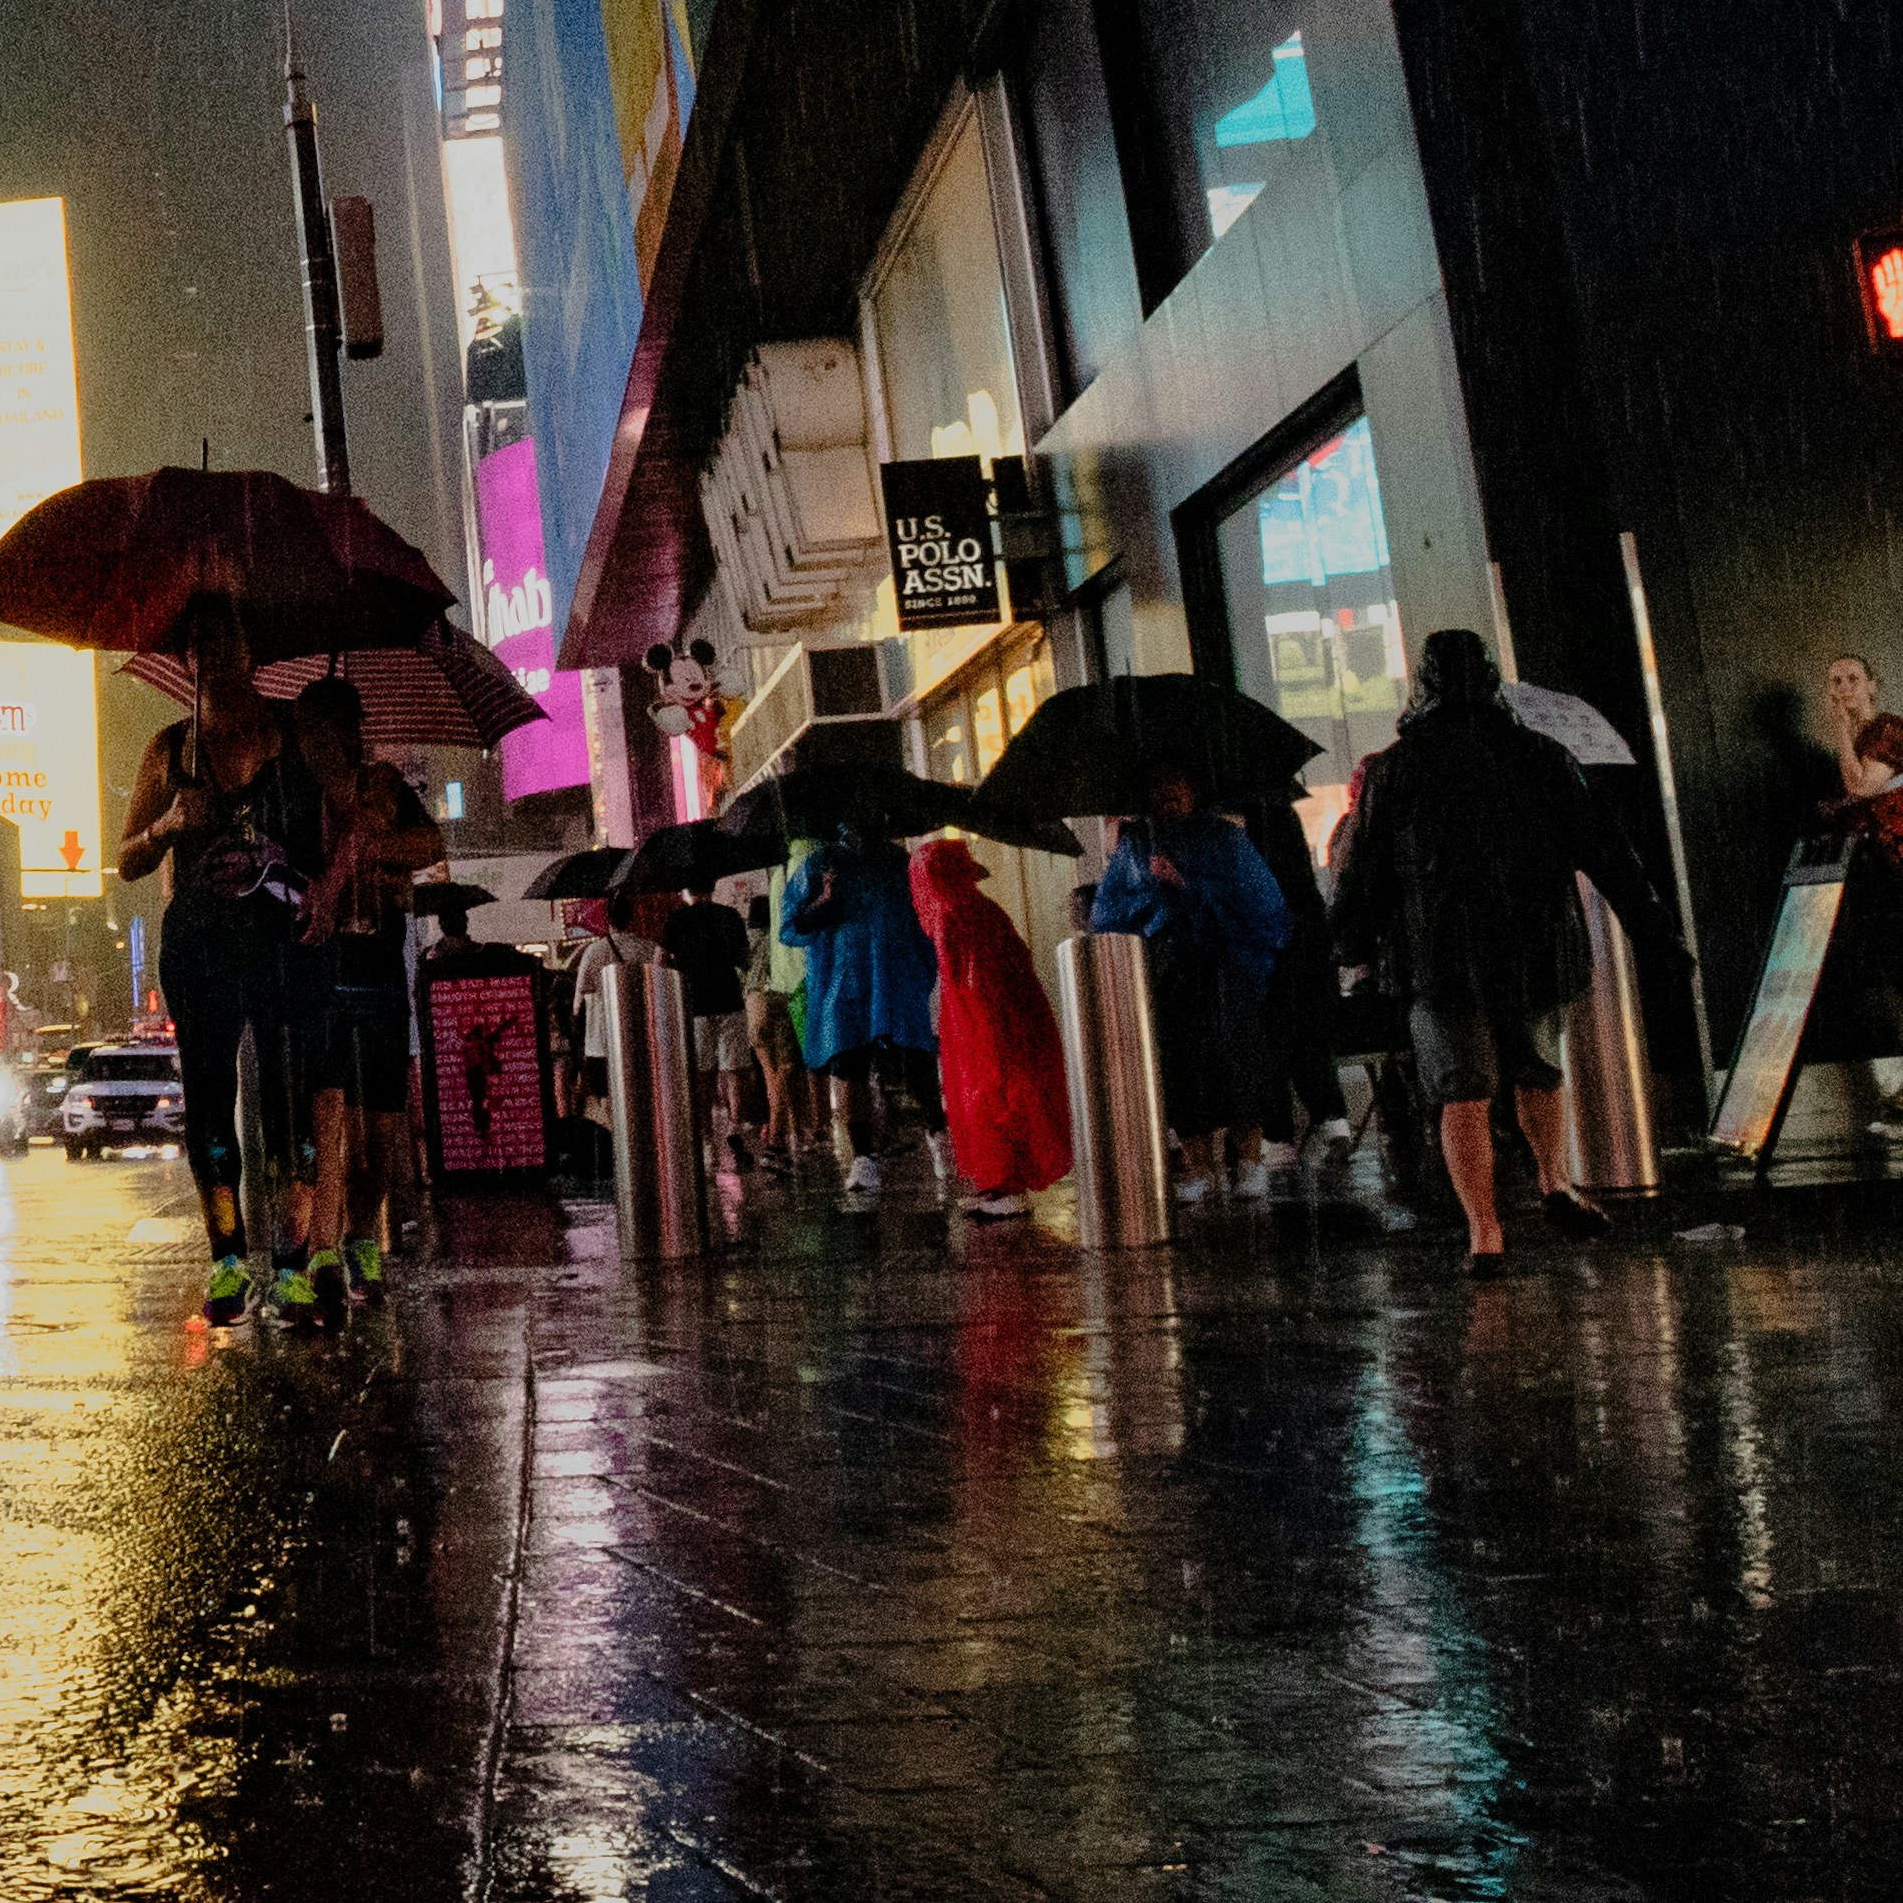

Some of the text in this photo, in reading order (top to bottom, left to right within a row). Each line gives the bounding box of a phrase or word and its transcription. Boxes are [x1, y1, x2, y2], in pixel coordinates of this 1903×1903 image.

[896, 515, 951, 542] U.S.
[898, 538, 982, 568] POLO
[902, 563, 992, 595] ASSN.
[905, 597, 943, 609] SINCE
